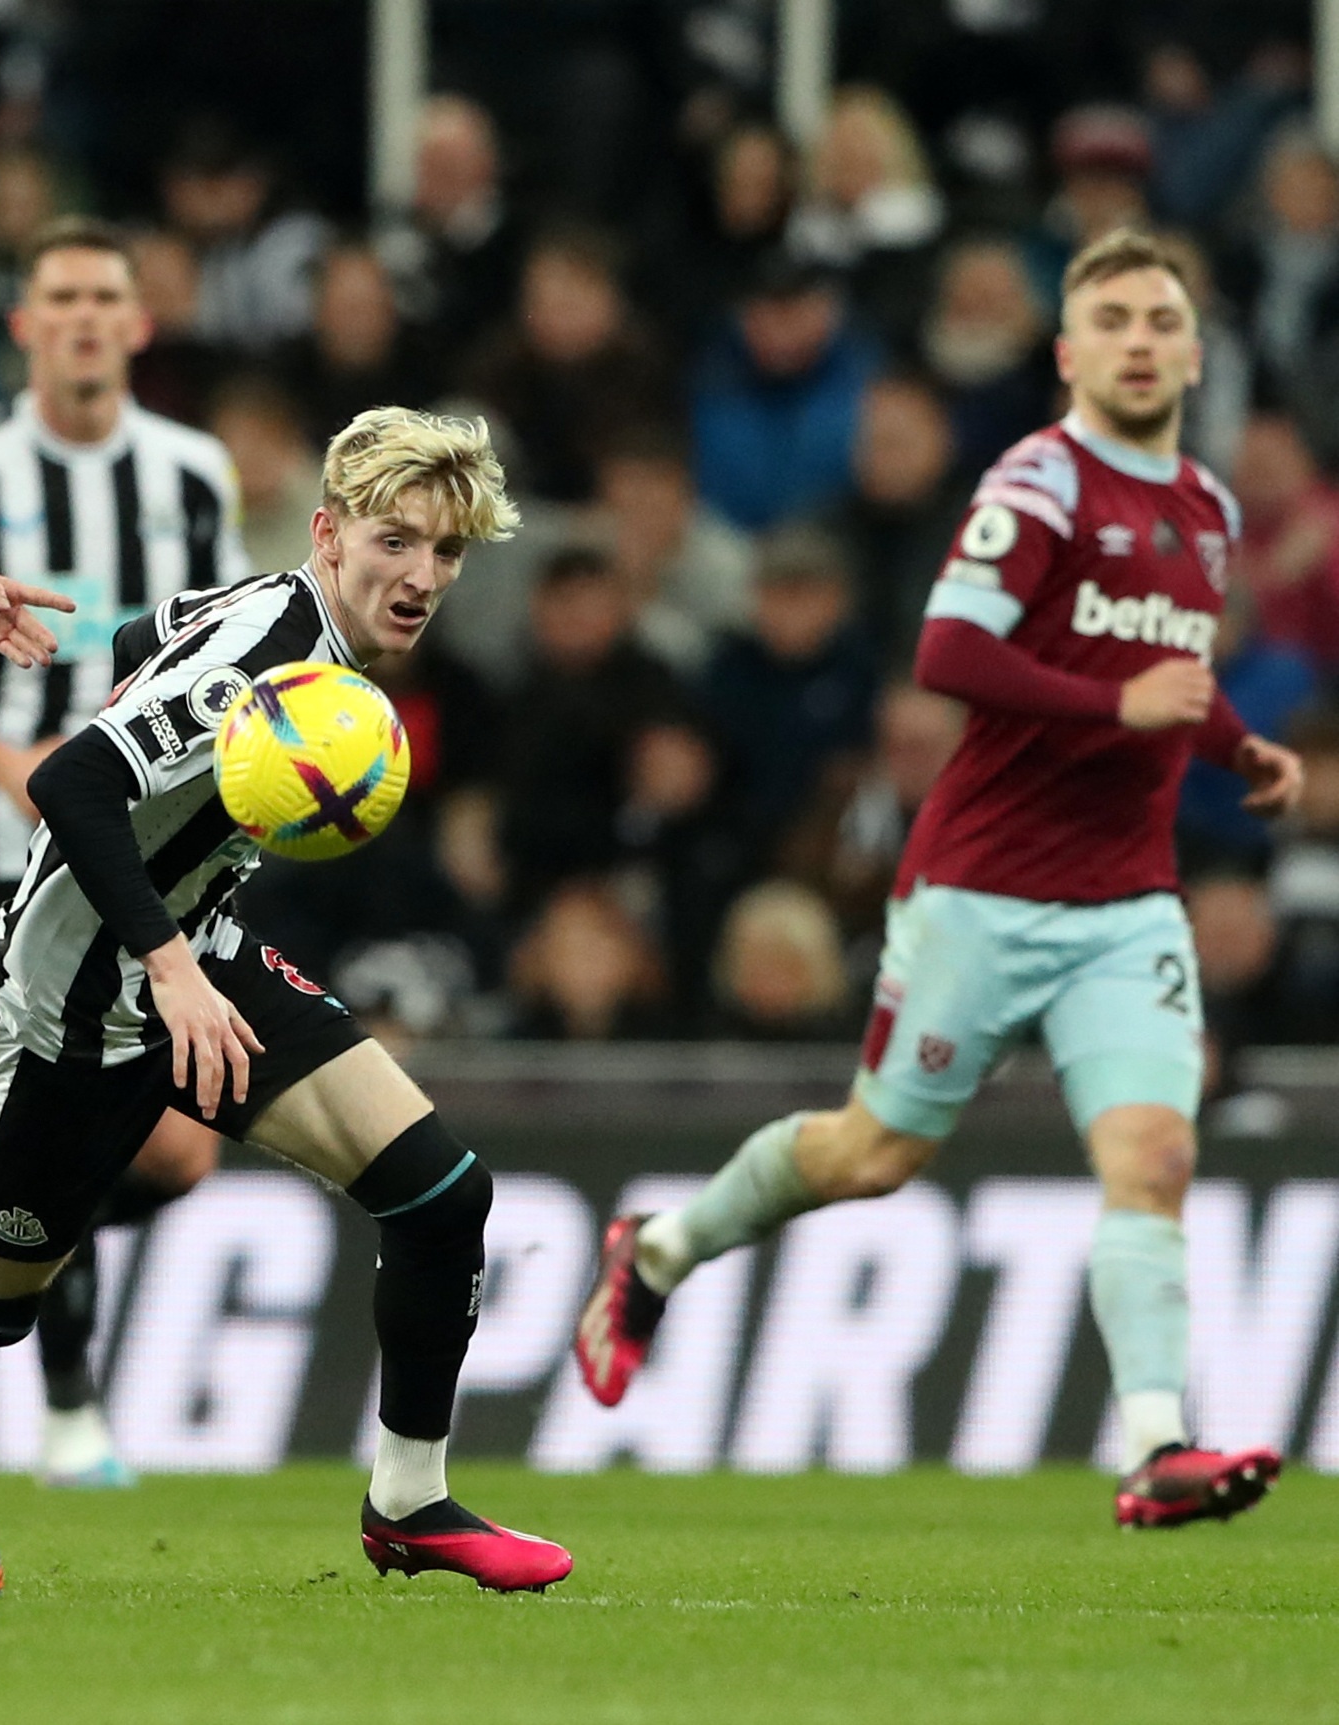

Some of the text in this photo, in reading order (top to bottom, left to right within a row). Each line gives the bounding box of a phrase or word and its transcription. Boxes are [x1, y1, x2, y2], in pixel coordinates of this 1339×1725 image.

[148, 718, 177, 762] racism
[160, 714, 183, 752] room
[349, 1170, 1339, 1478] PARTN
